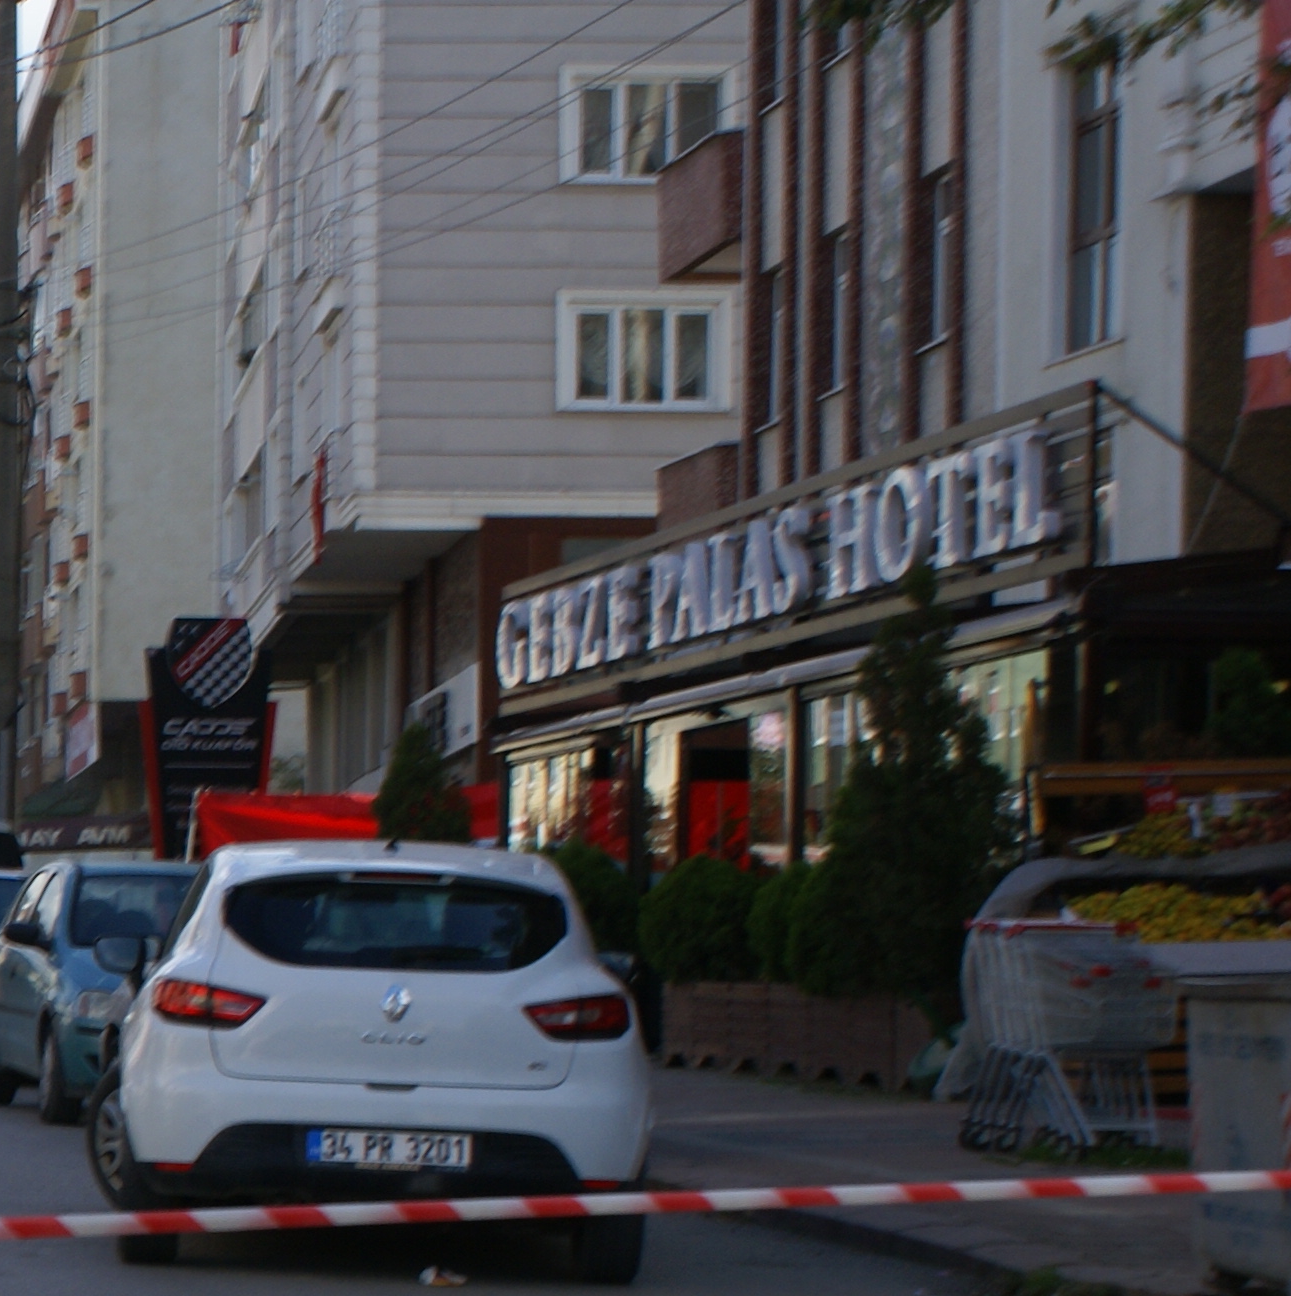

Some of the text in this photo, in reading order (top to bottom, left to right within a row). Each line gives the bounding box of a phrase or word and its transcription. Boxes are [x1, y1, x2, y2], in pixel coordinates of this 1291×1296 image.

[496, 429, 1062, 689] GEBZE PALAS HOTEL
[322, 1133, 465, 1164] 34 PR 3201
